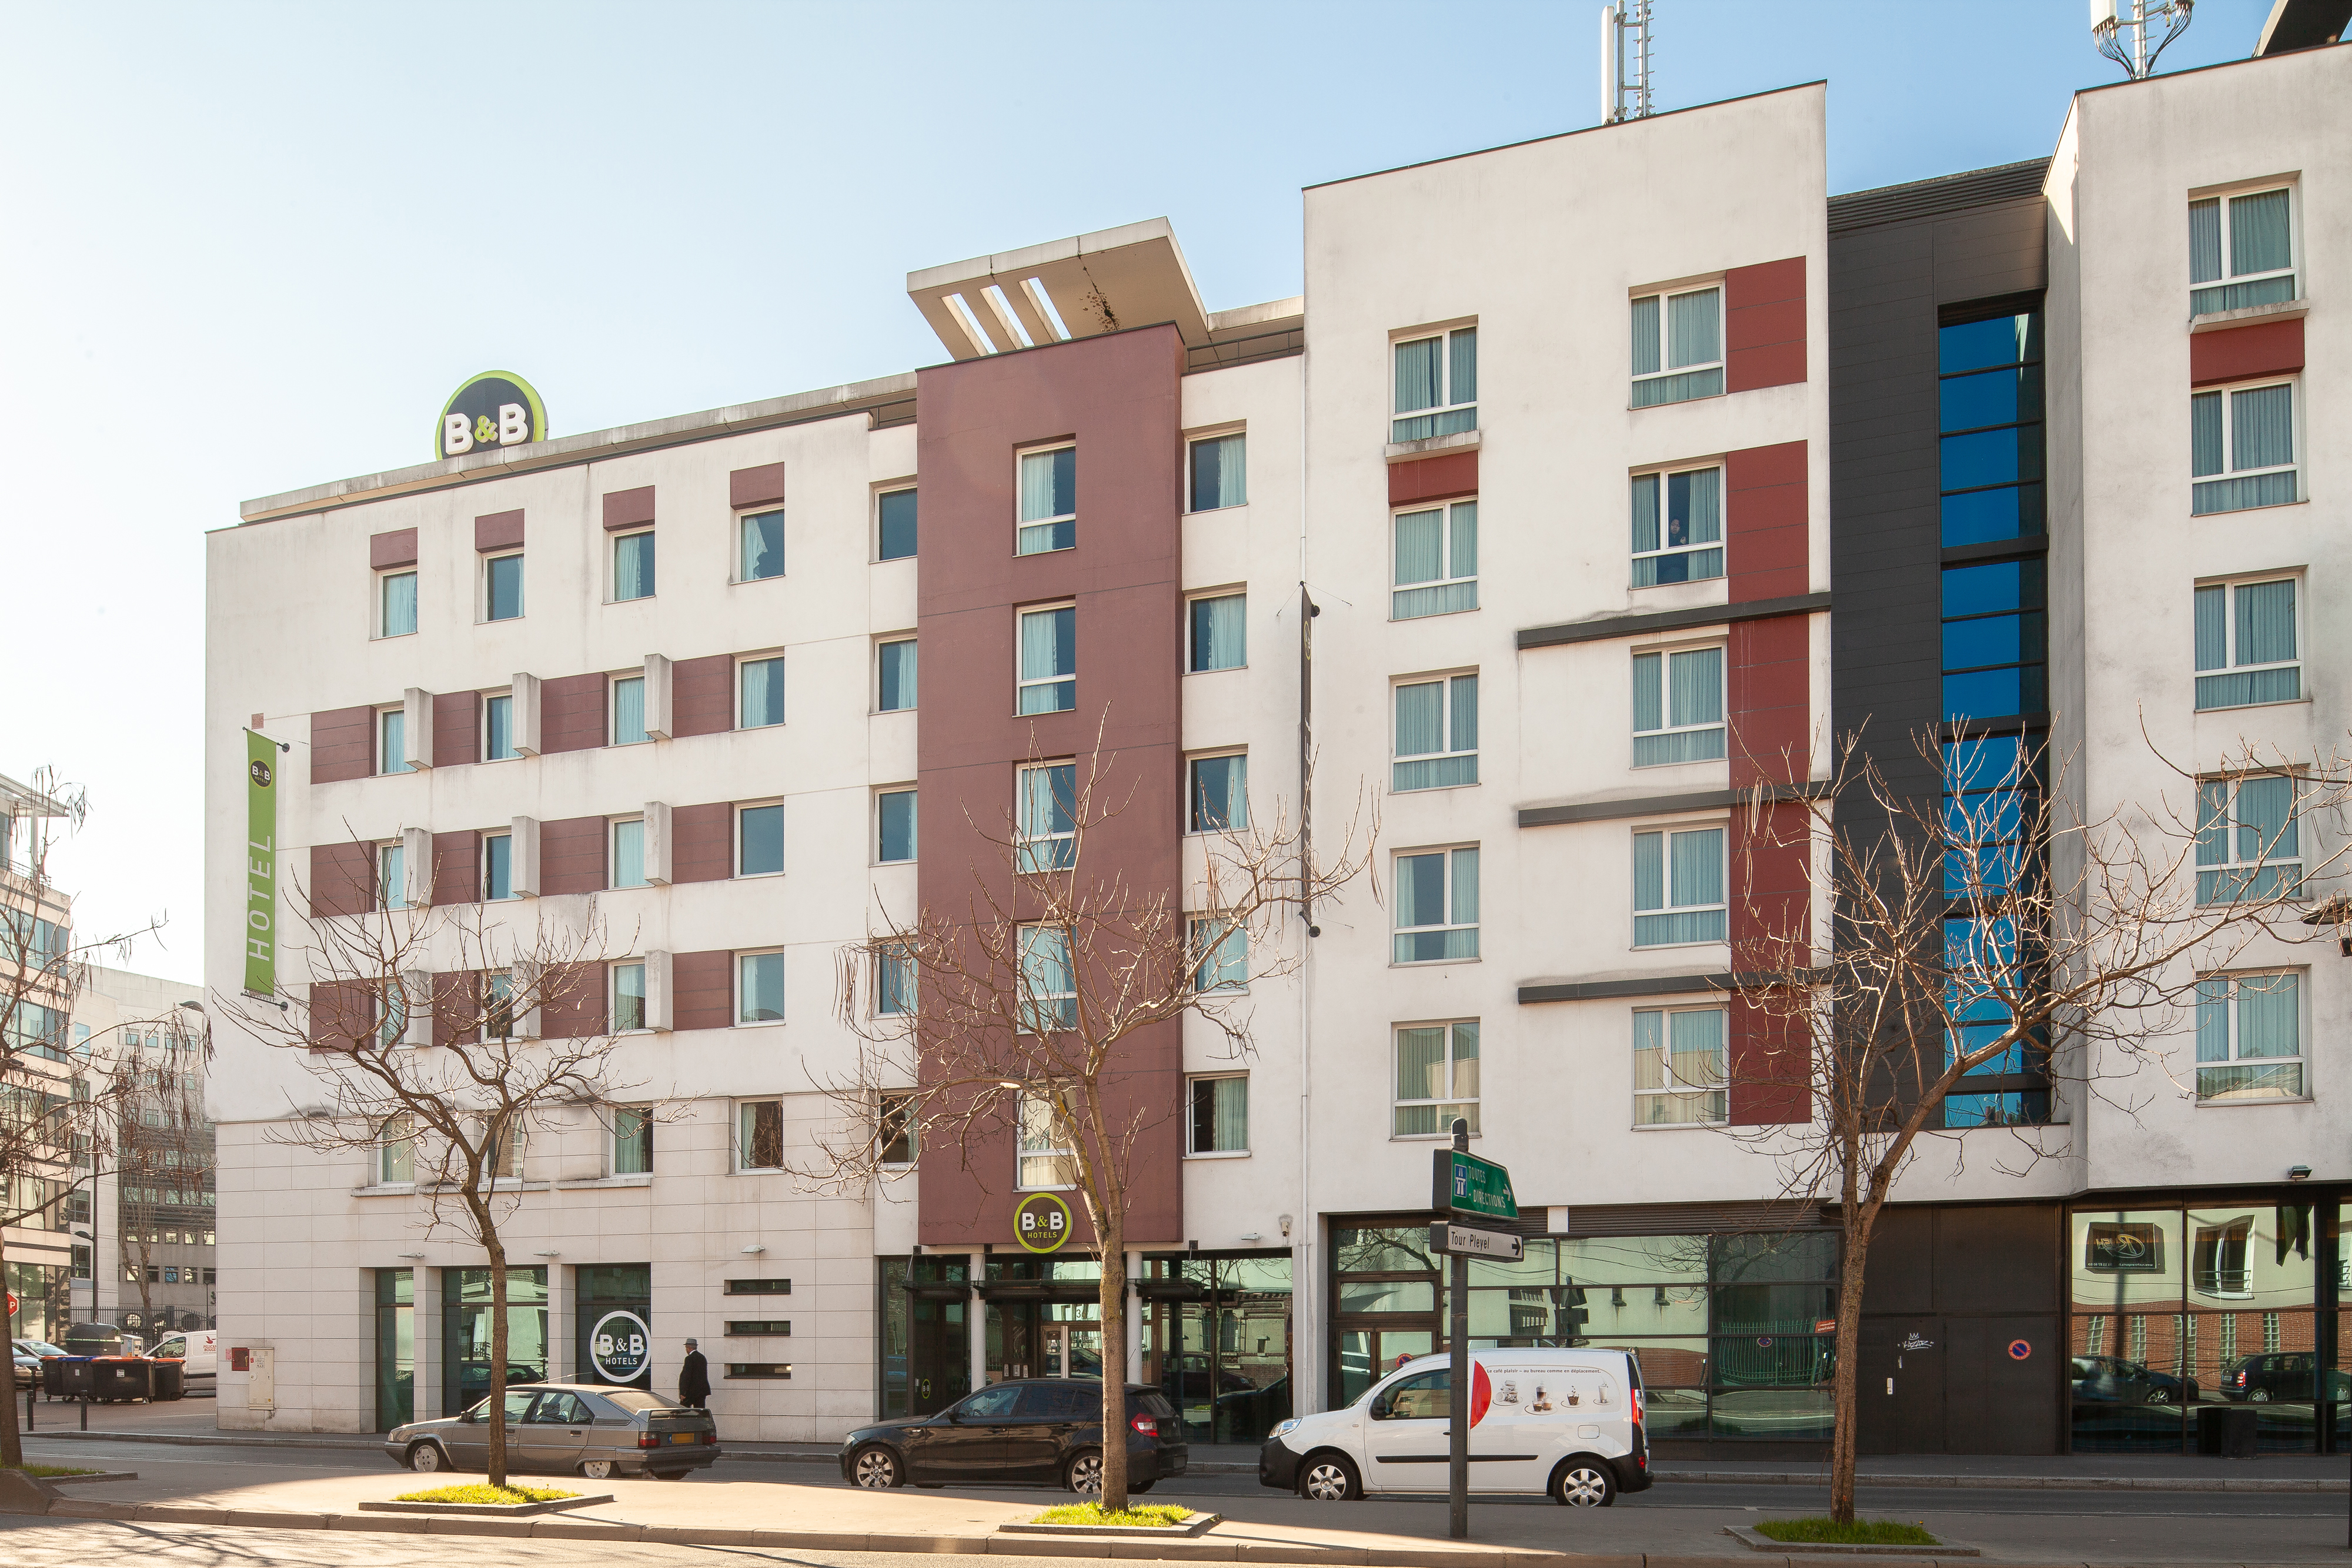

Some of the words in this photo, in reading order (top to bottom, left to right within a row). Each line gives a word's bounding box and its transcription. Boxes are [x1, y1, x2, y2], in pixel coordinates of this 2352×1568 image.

[445, 403, 528, 455] B&B
[252, 765, 270, 781] B&B
[255, 775, 268, 784] HOTELS
[248, 835, 270, 961] HOTEL
[1469, 1166, 1486, 1183] TOUTES
[1474, 1189, 1506, 1208] DIRECTIONS
[1022, 1212, 1064, 1231] B&B
[1452, 1231, 1466, 1246] Tour
[1470, 1234, 1489, 1251] Pleyel
[600, 1334, 644, 1355] B&B
